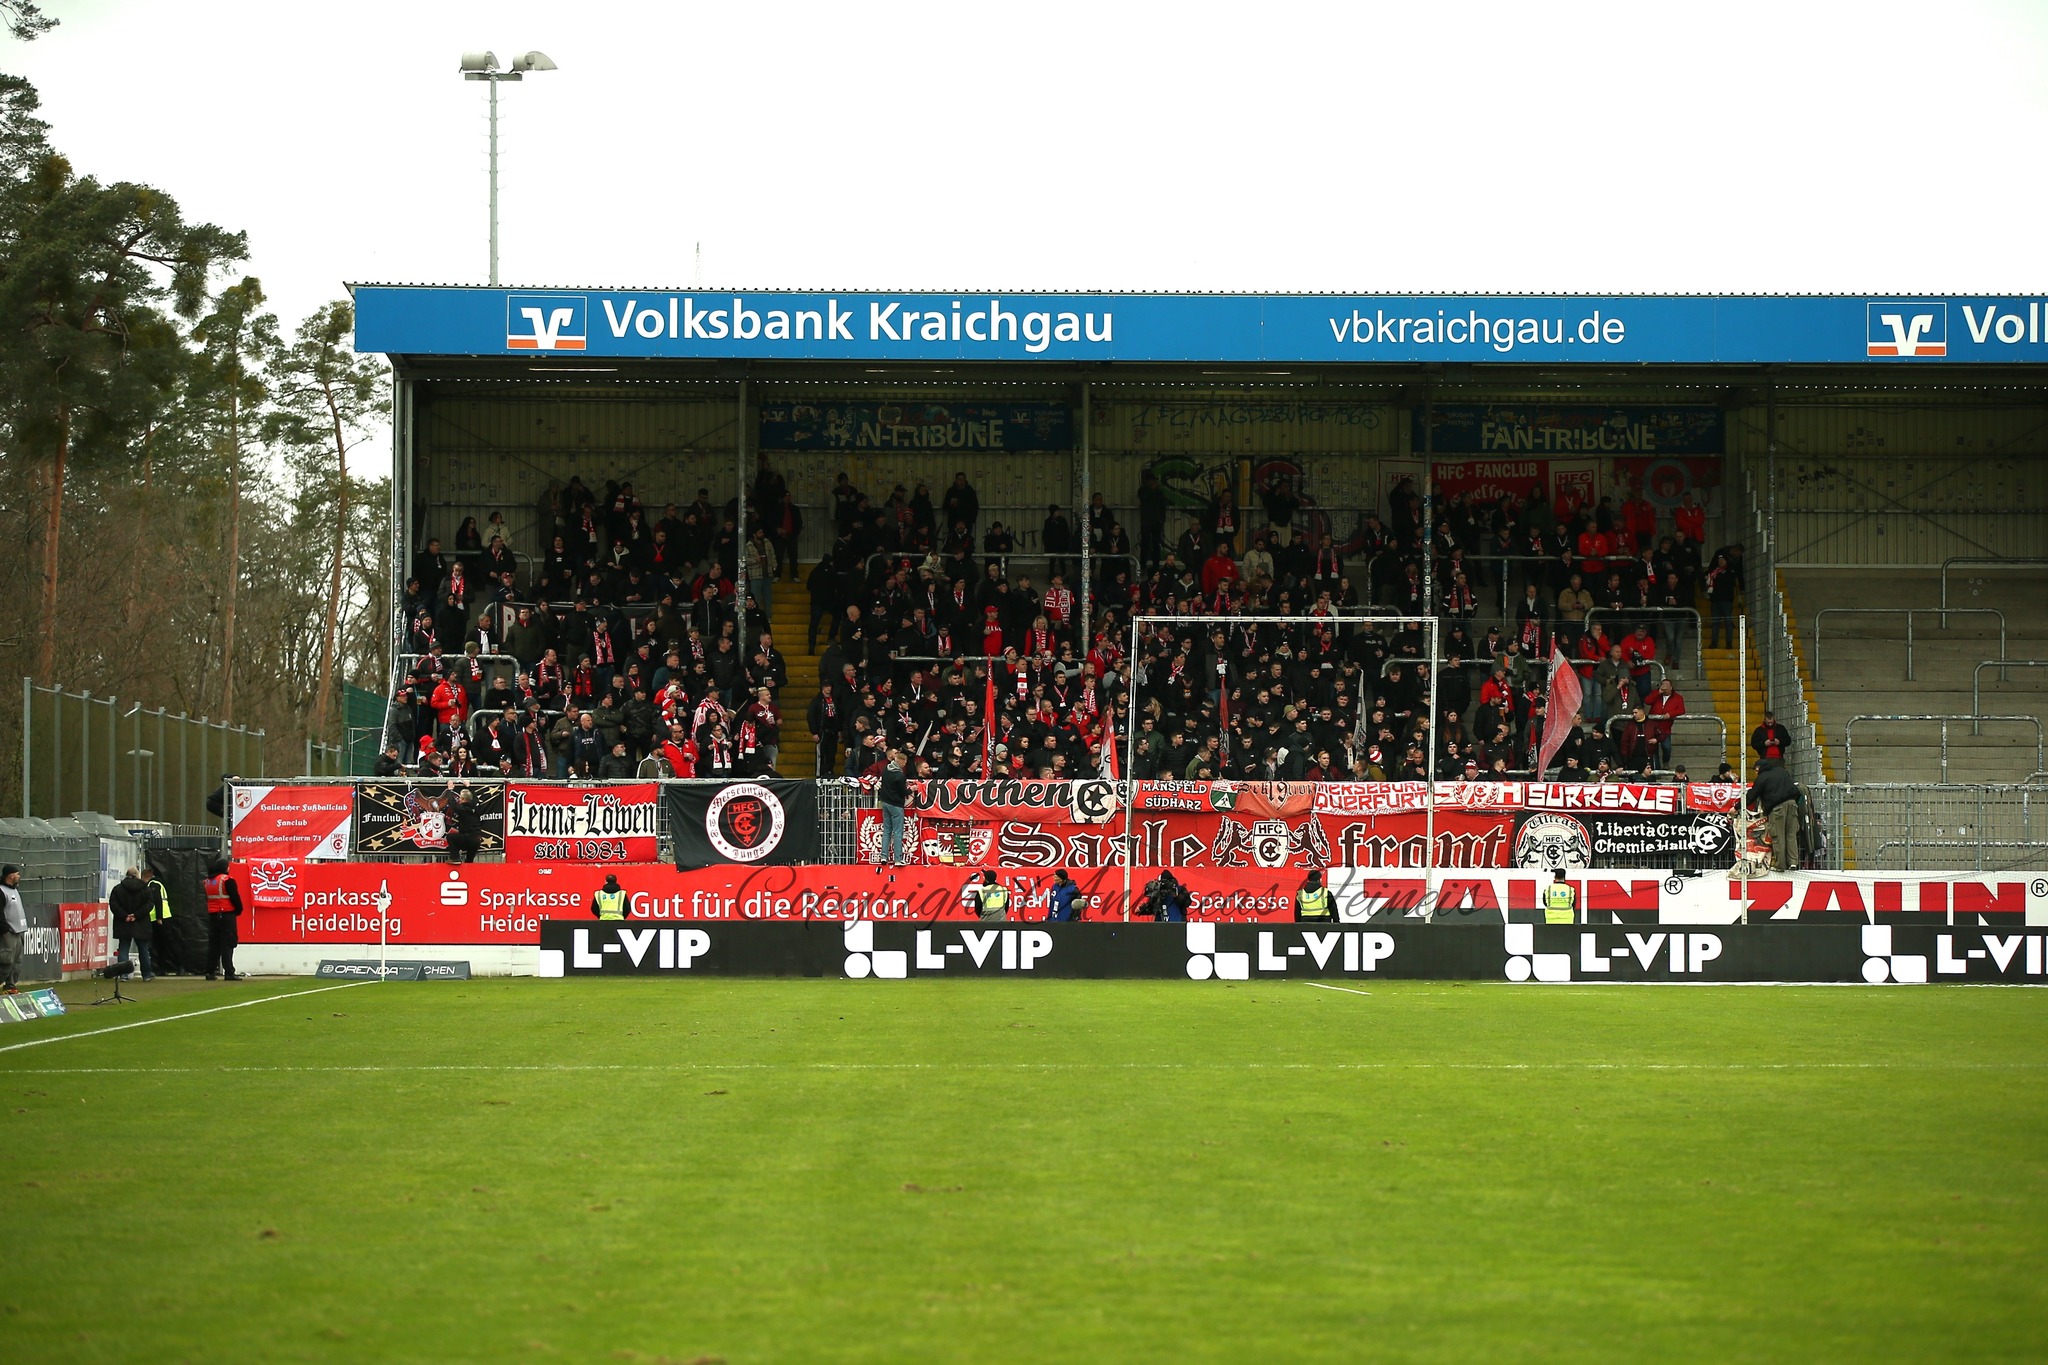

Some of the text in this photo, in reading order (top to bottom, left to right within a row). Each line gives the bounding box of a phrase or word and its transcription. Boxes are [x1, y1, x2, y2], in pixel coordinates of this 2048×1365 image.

[603, 299, 1113, 352] Volksbank Kraichgau
[1329, 311, 1626, 352] vbkraichgau.de
[1962, 303, 2048, 344] Vol
[1437, 465, 1464, 480] HFC
[1475, 463, 1538, 479] FANCLUB
[1557, 472, 1592, 484] HFC
[712, 786, 773, 809] Merseburger
[1142, 782, 1207, 794] MANSFELD
[733, 803, 754, 811] HFC
[1145, 797, 1202, 810] SÜDHARZ
[1528, 784, 1674, 812] SURREALE
[261, 804, 348, 813] Hallescher Fußballclub
[362, 813, 401, 823] Fanclub
[509, 790, 656, 836] Leuna-Löwen
[276, 819, 307, 827] Fanclub
[1258, 824, 1283, 834] HFC
[1528, 814, 1578, 830] Ultras
[1595, 821, 1655, 837] Libertà
[1705, 813, 1728, 827] HFC
[534, 841, 626, 860] seit 1984
[732, 846, 764, 859] Jungs
[999, 819, 1207, 867] Saale
[1339, 822, 1507, 868] front
[1595, 838, 1696, 854] Chemie Halle
[480, 888, 581, 909] Sparkasse
[631, 890, 918, 924] Gut für die Region.
[1189, 891, 1289, 910] Sparkasse
[573, 928, 711, 969] L-VIP
[916, 929, 1053, 970] L-VIP
[1258, 931, 1395, 972] L-VIP
[1580, 932, 1723, 973] L-VIP
[1937, 934, 2048, 975] L-VI
[334, 965, 399, 976] ORENDA
